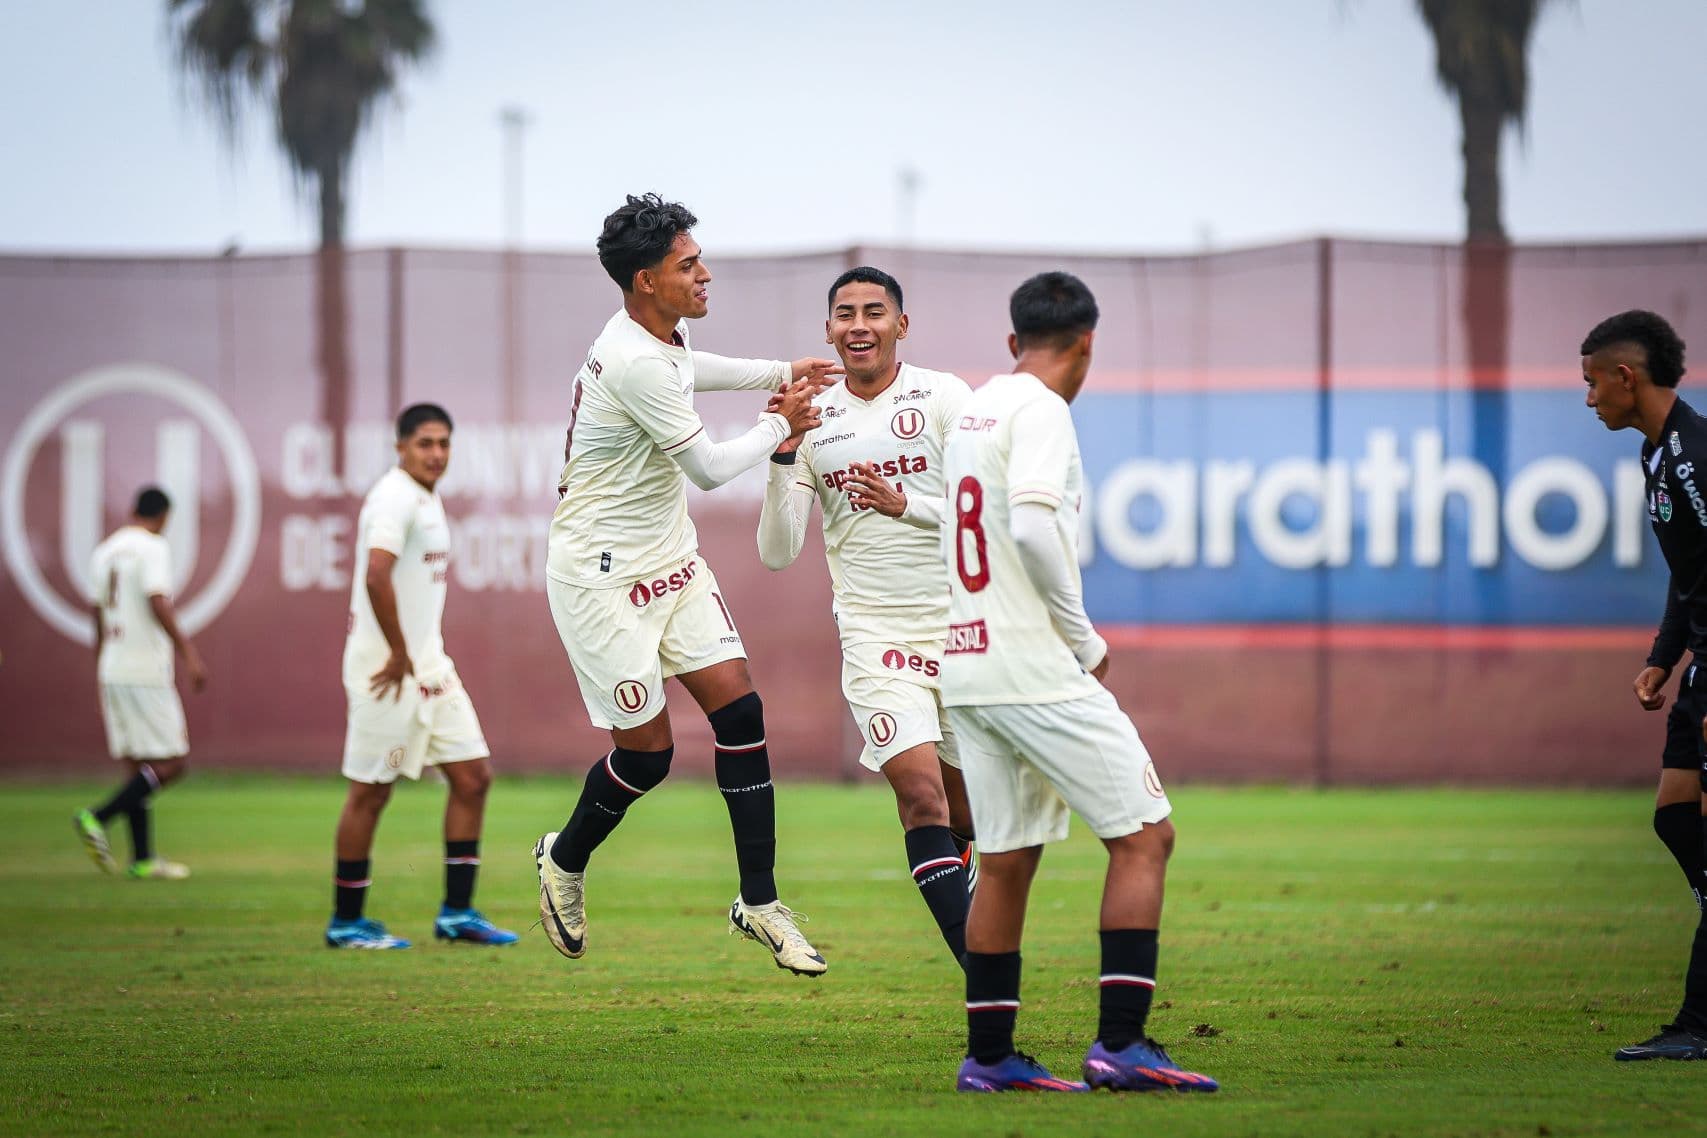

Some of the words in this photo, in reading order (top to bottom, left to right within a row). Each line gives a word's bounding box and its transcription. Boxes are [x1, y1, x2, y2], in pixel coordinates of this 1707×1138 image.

[898, 412, 917, 436] U
[811, 432, 856, 449] marathon
[60, 420, 198, 606] U
[956, 475, 991, 593] 8
[281, 513, 351, 590] DE
[619, 685, 642, 710] U
[871, 716, 891, 743] U
